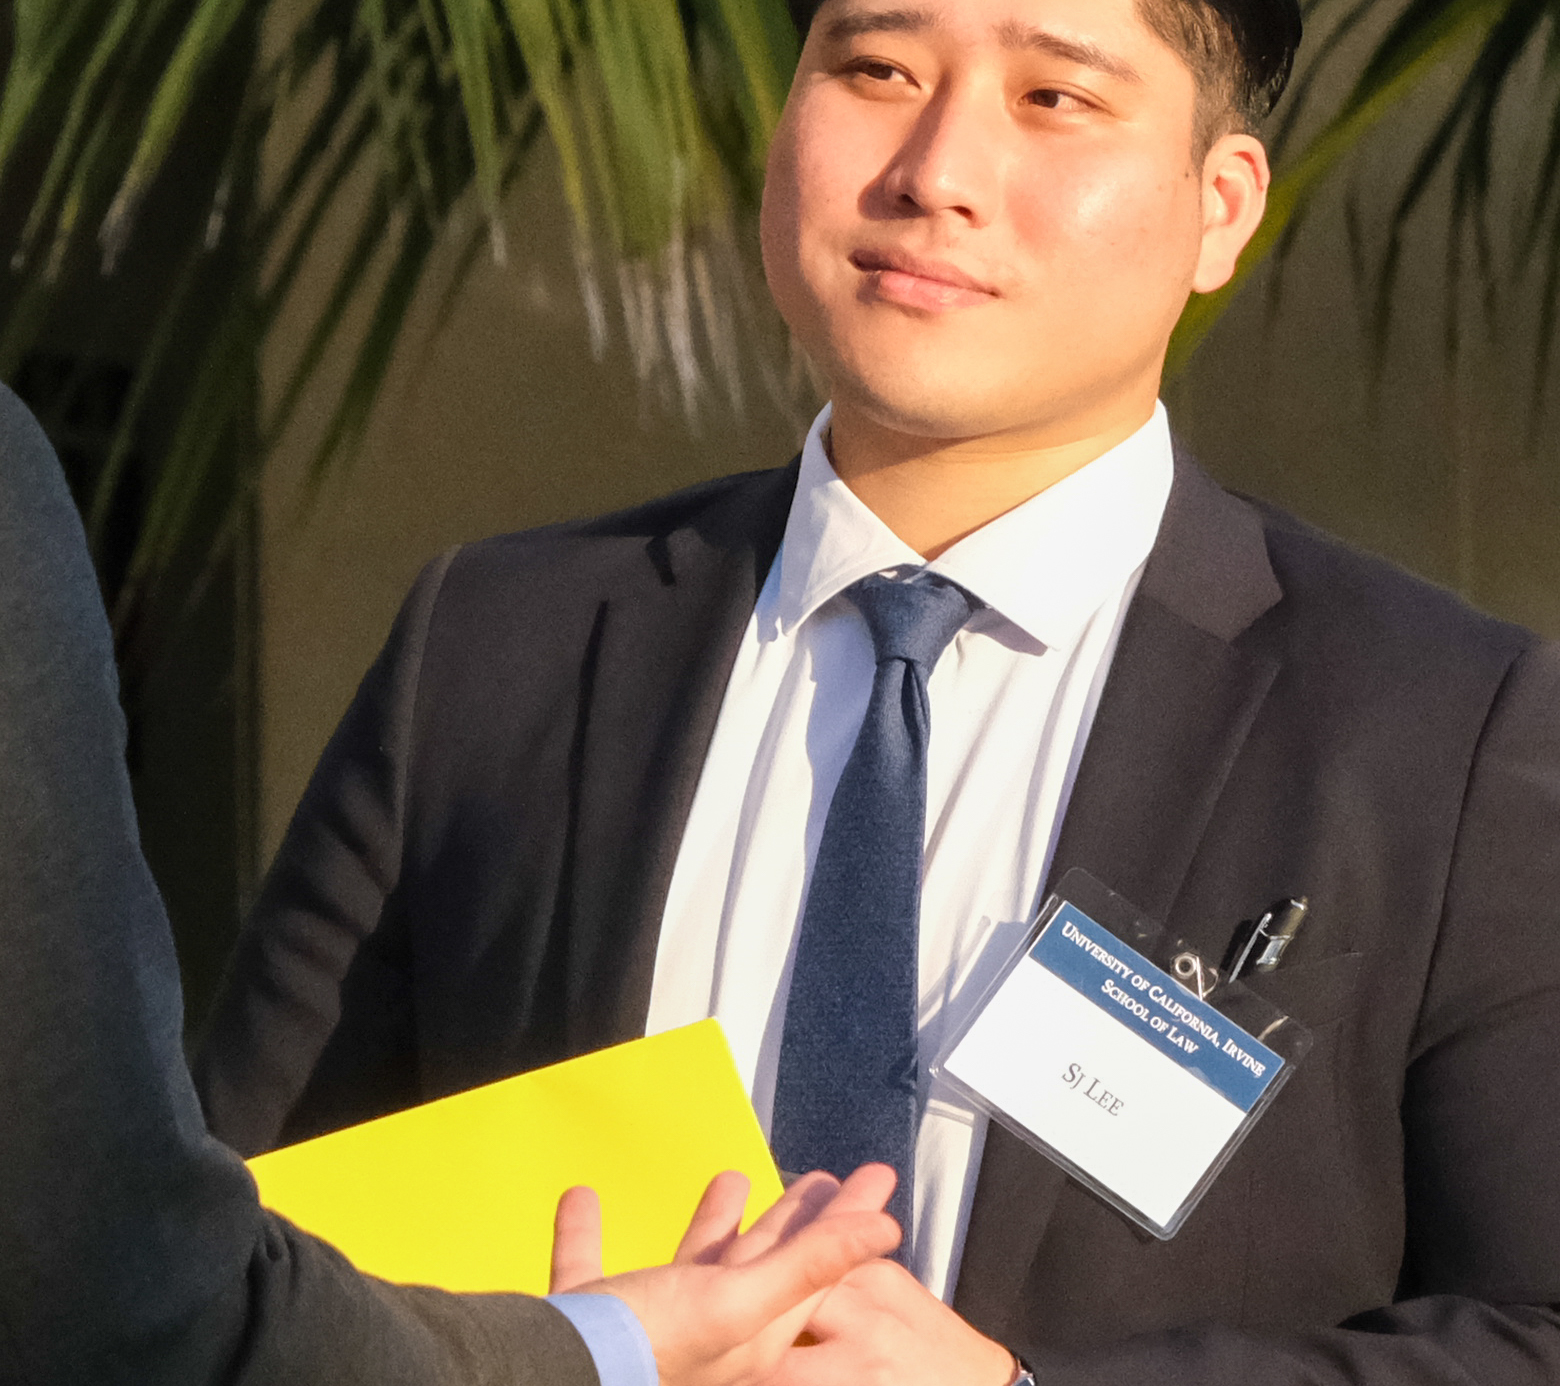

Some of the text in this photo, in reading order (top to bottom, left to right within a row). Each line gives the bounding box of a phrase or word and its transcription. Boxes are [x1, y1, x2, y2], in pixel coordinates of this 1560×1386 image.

[1061, 921, 1266, 1077] UNIVERSITY OF CALIFORNIA, IRVINE
[1101, 979, 1199, 1054] SCHOOL OF LAW
[1083, 1077, 1124, 1117] LEE
